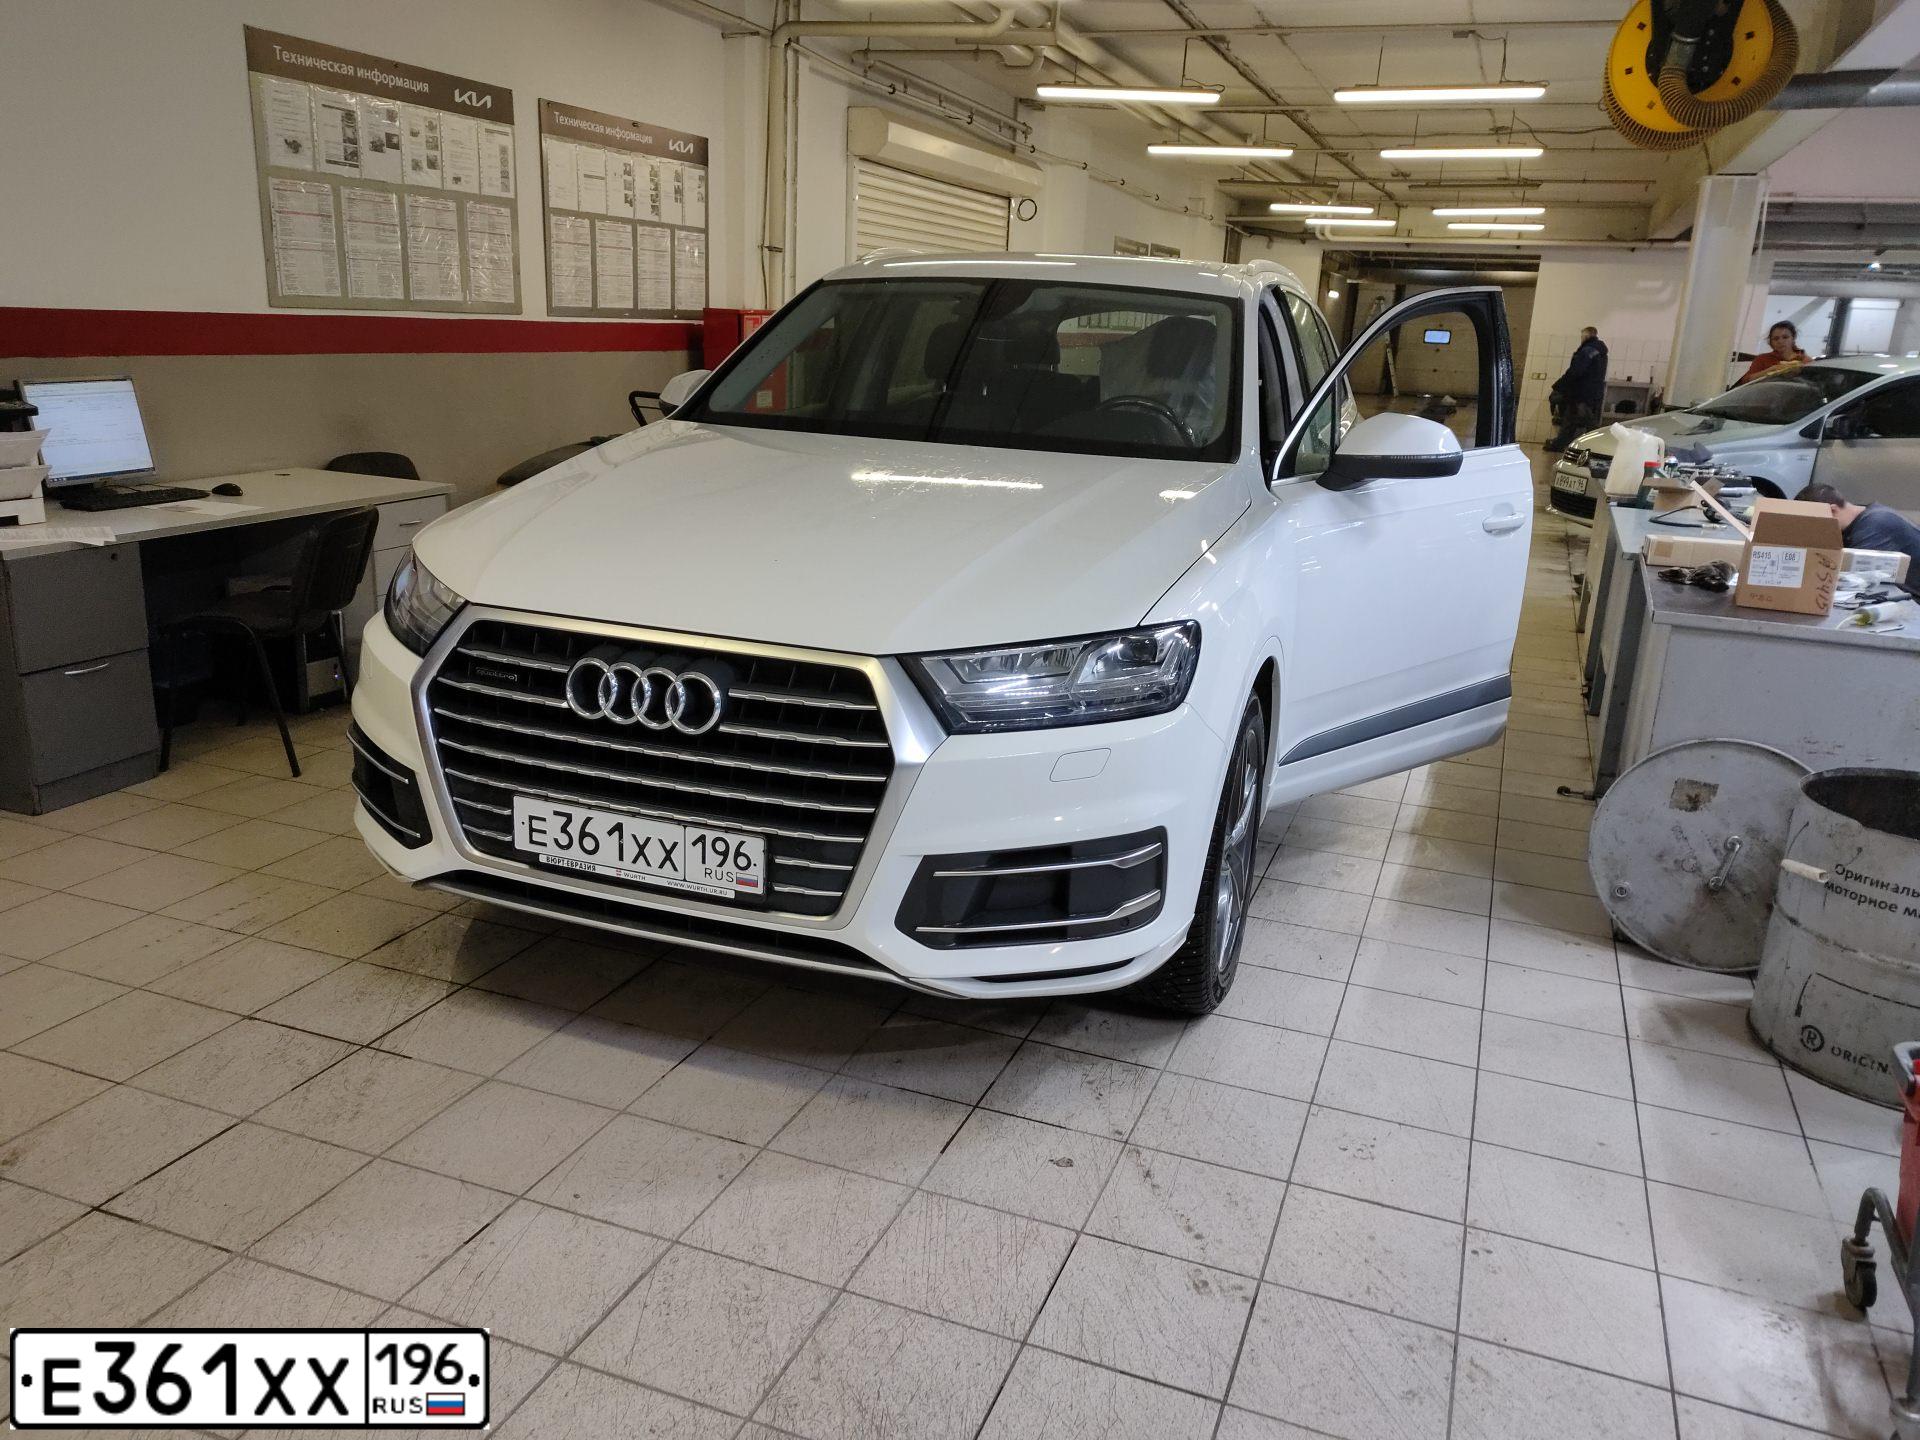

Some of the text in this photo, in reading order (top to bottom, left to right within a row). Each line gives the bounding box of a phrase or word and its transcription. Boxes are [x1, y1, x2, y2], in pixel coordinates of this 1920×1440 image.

[273, 45, 429, 93] Техническая информация
[553, 111, 653, 144] Техническая информация
[546, 856, 596, 871] ВЮРТ-ЕВРАЗИЯ
[691, 833, 752, 871] 196
[704, 867, 734, 883] RUS
[1823, 881, 1920, 919] моторное м
